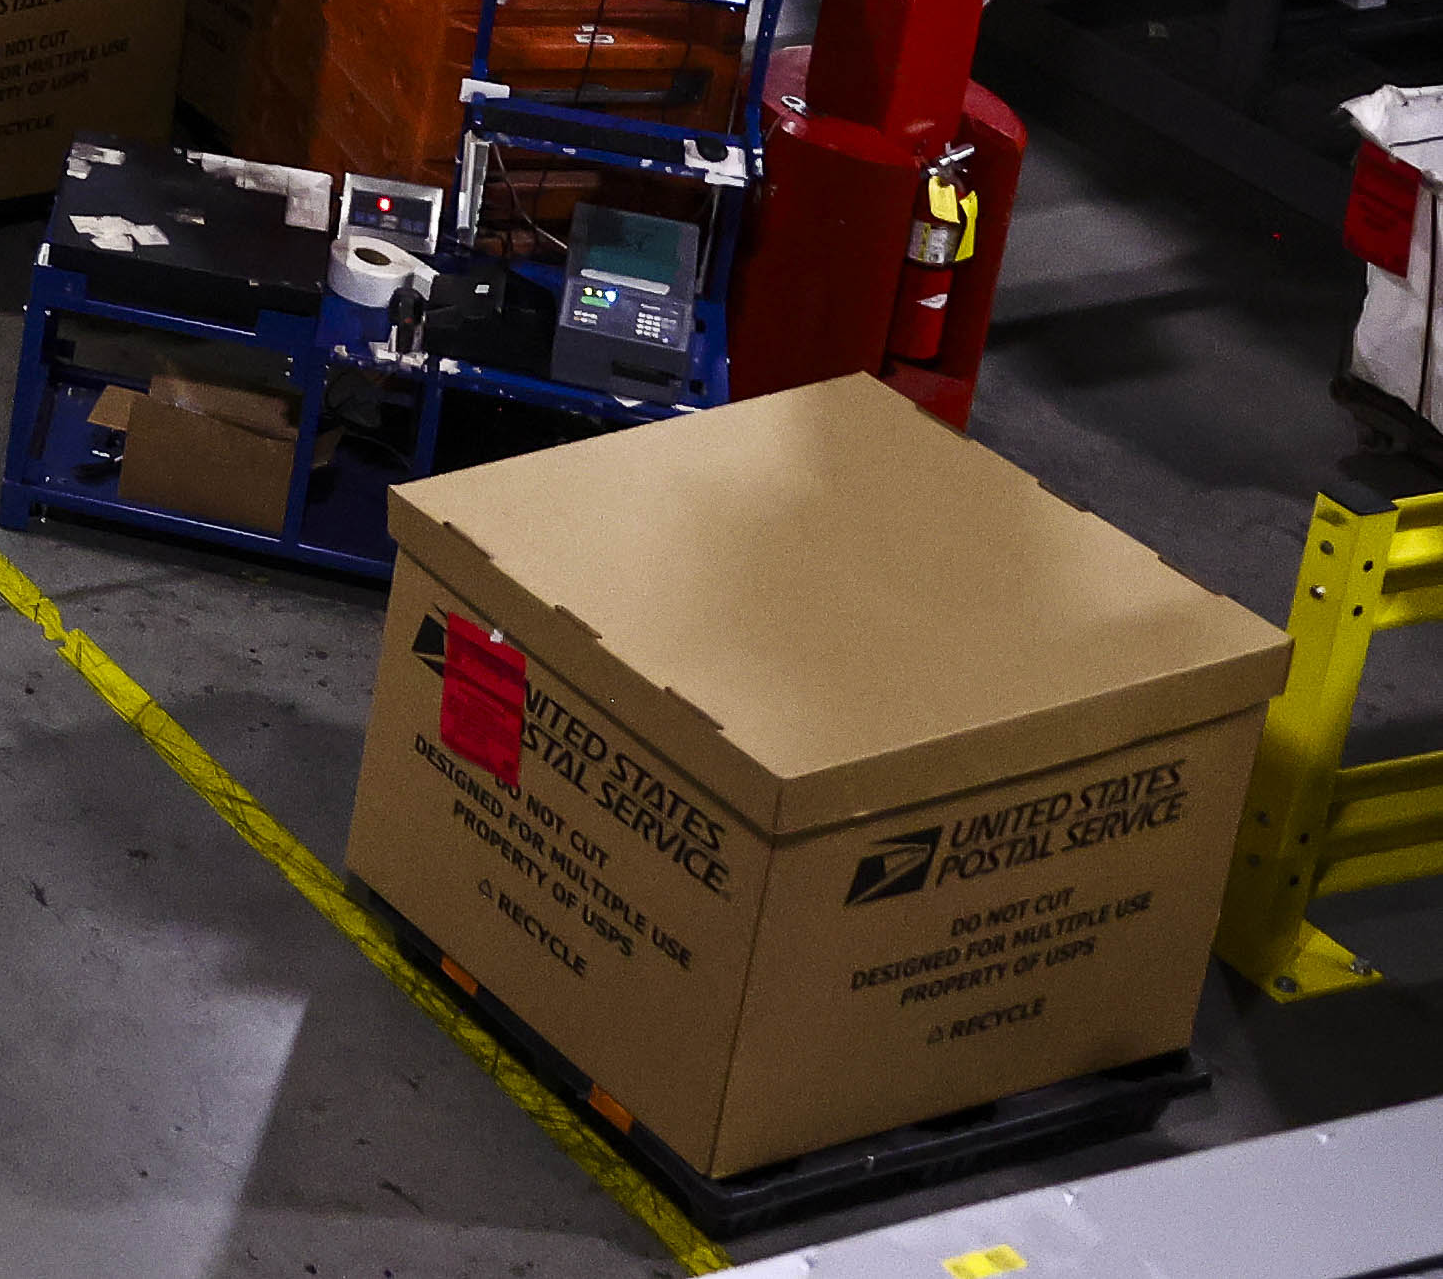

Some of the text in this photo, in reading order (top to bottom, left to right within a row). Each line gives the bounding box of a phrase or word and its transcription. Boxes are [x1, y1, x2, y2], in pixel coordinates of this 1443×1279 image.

[928, 790, 1193, 888] POSTAL SERVICE
[942, 759, 1187, 851] UNITED STATES
[851, 893, 1154, 990] DESIGNED FOR MULTIPLE USE
[944, 887, 1072, 938] DO NOT CUT
[898, 938, 1095, 1007] PROPERTY OF USPS
[950, 1000, 1047, 1042] RECYCLE
